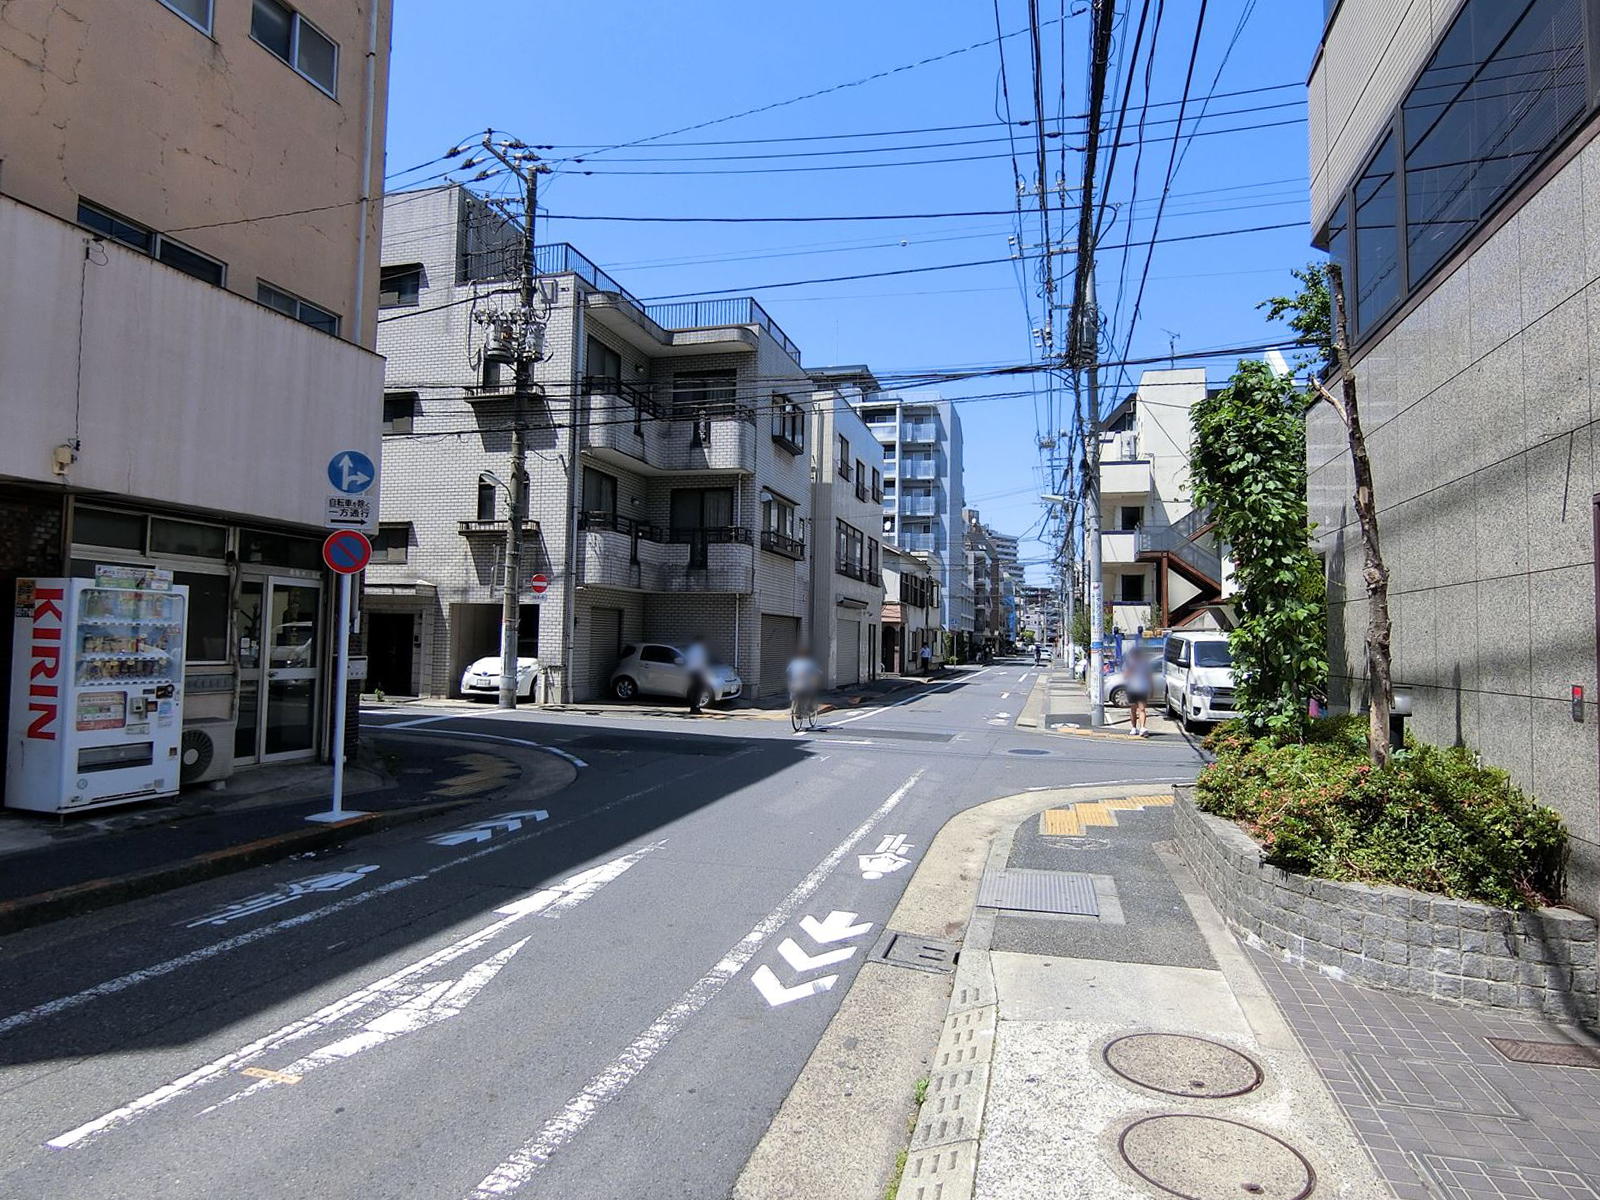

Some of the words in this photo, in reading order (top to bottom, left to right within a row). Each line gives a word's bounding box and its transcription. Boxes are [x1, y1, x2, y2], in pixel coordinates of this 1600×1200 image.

[329, 498, 371, 509] 自転車を除く
[328, 508, 371, 519] 一方通行
[27, 588, 64, 741] KIRIN
